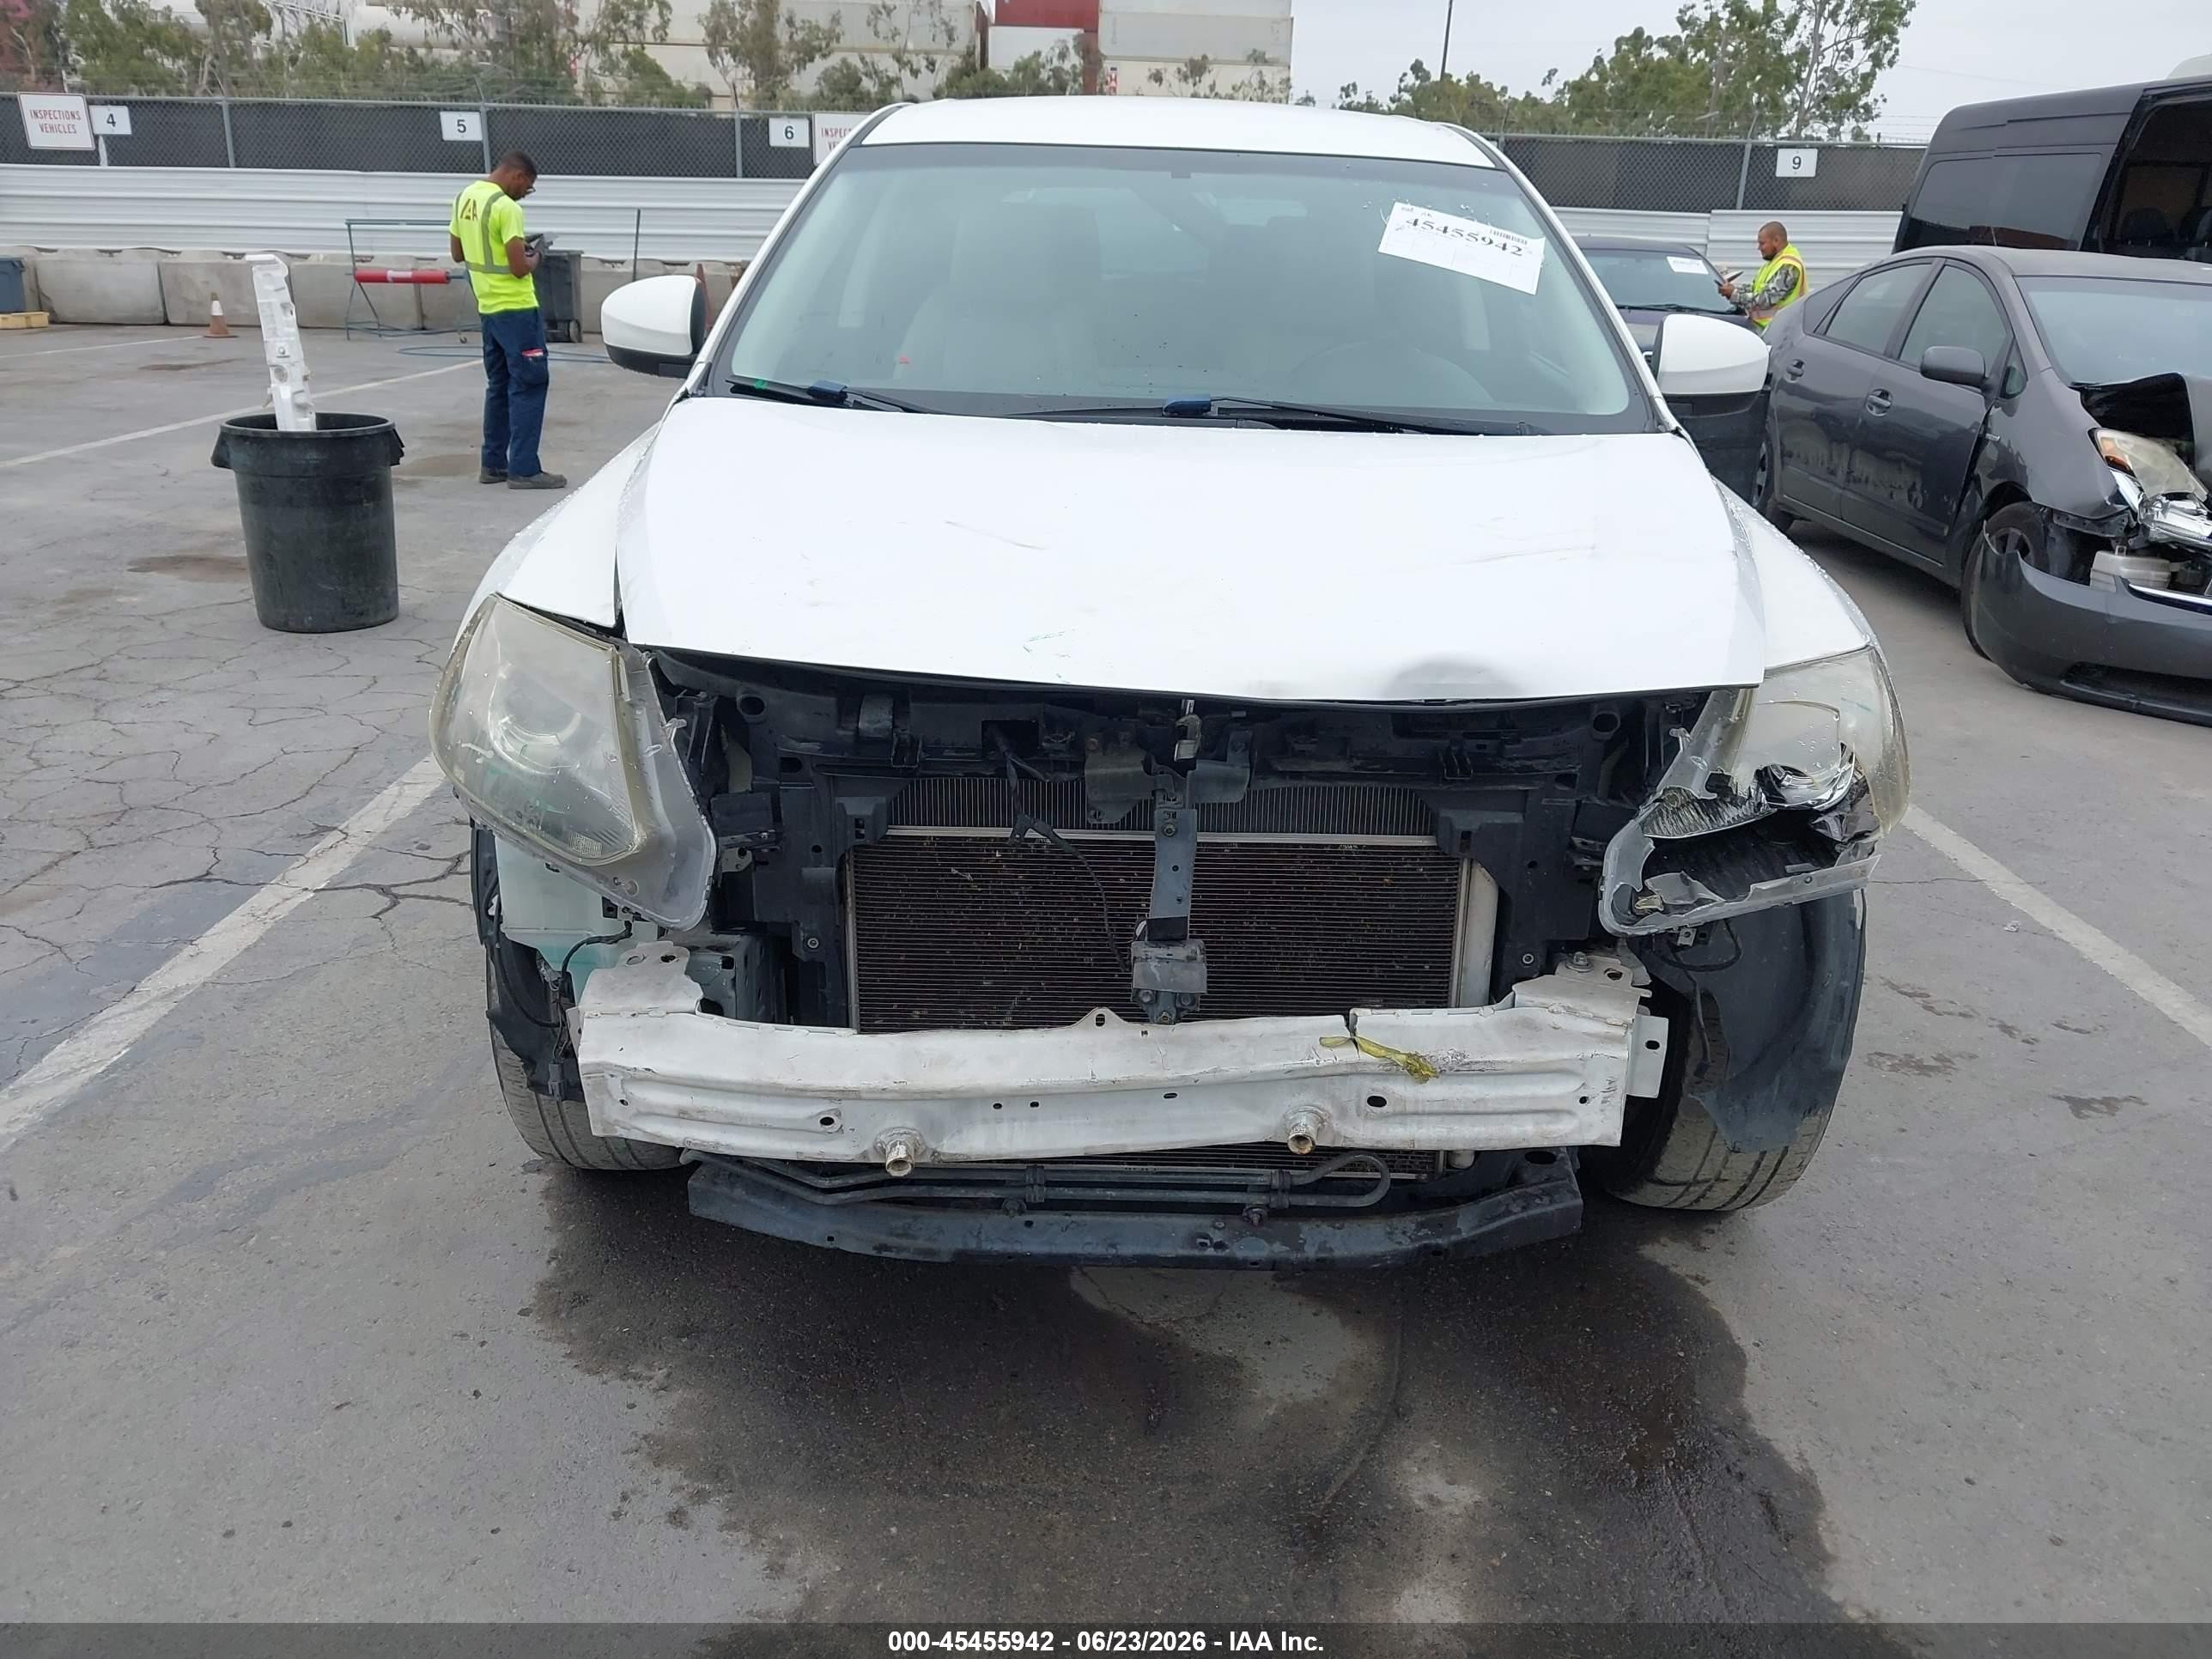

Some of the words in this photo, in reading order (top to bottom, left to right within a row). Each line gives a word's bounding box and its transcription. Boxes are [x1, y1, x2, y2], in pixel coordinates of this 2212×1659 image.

[29, 109, 82, 121] INSPECTIONS
[106, 112, 117, 128] 4
[39, 123, 77, 135] VEHICLES
[457, 118, 467, 133] 5
[784, 125, 794, 140] 6
[1792, 155, 1802, 170] 9
[1405, 217, 1524, 258] 45455942
